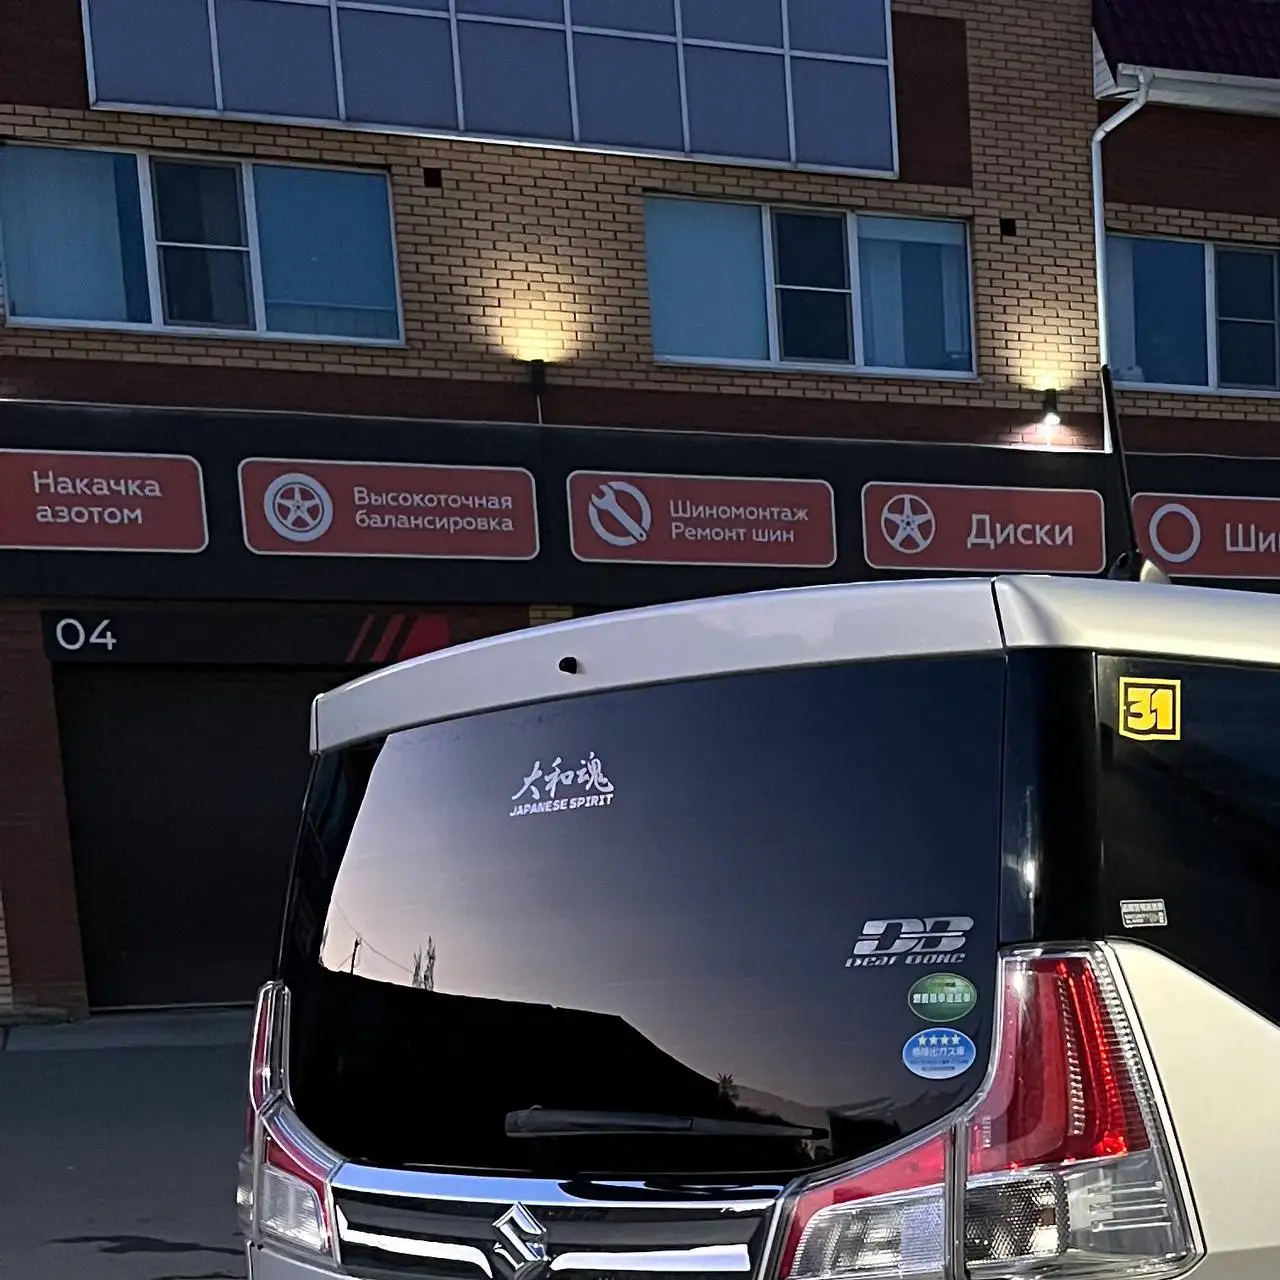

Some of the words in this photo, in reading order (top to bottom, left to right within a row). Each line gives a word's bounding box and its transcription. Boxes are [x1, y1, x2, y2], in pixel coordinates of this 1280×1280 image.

[33, 470, 162, 498] Накачка
[353, 486, 513, 510] Высокоточная
[35, 503, 143, 525] азотом
[354, 508, 514, 533] балансировка
[668, 498, 810, 524] Шиномонтаж
[670, 520, 747, 542] Ремонт
[752, 525, 795, 544] шин
[967, 512, 1075, 548] Диски
[55, 617, 118, 651] 04
[1126, 686, 1174, 731] 31
[509, 798, 569, 817] JAPANESE
[569, 793, 614, 809] SPIRIT
